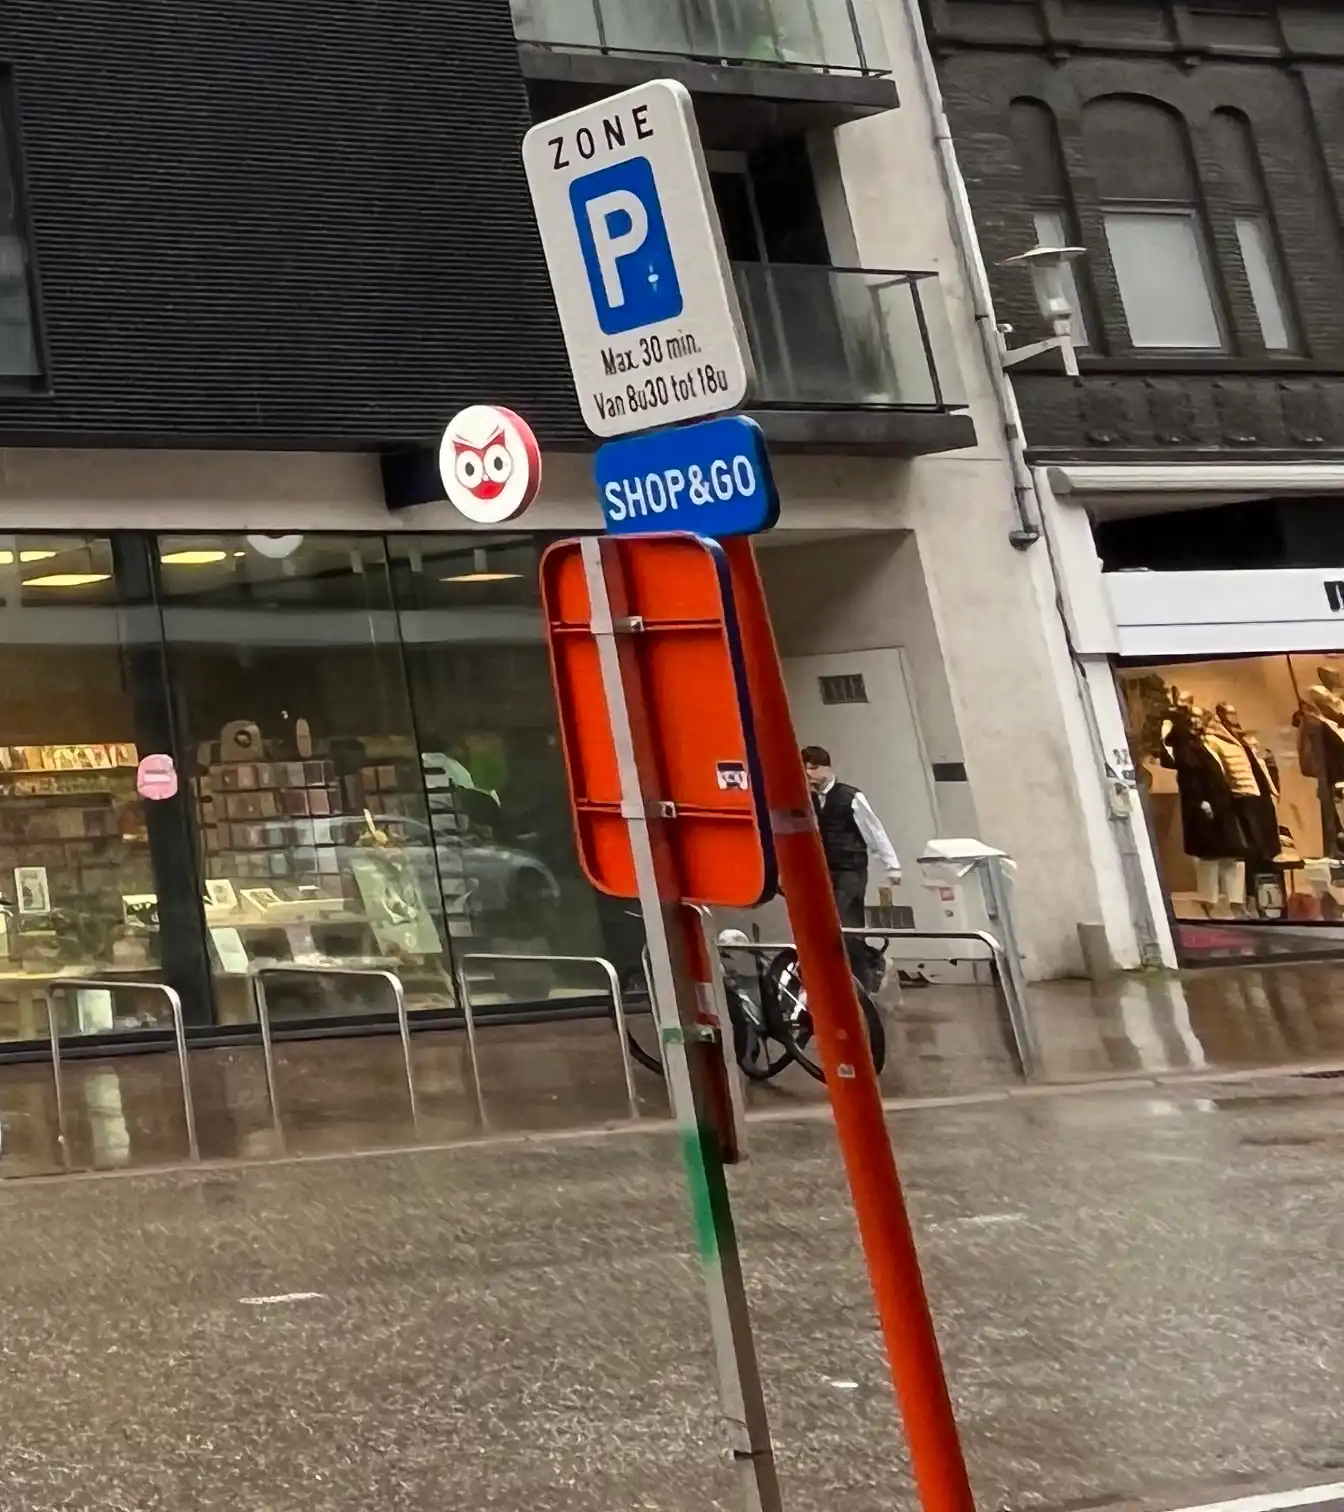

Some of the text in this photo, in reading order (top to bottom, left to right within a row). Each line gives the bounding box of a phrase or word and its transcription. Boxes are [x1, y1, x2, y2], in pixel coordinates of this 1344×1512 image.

[548, 104, 654, 170] ZONE
[585, 190, 648, 308] P
[639, 335, 663, 366] 30
[666, 329, 701, 360] min.
[593, 364, 728, 420] Van 8u30 tot 18u
[605, 455, 756, 521] SHOP&GO
